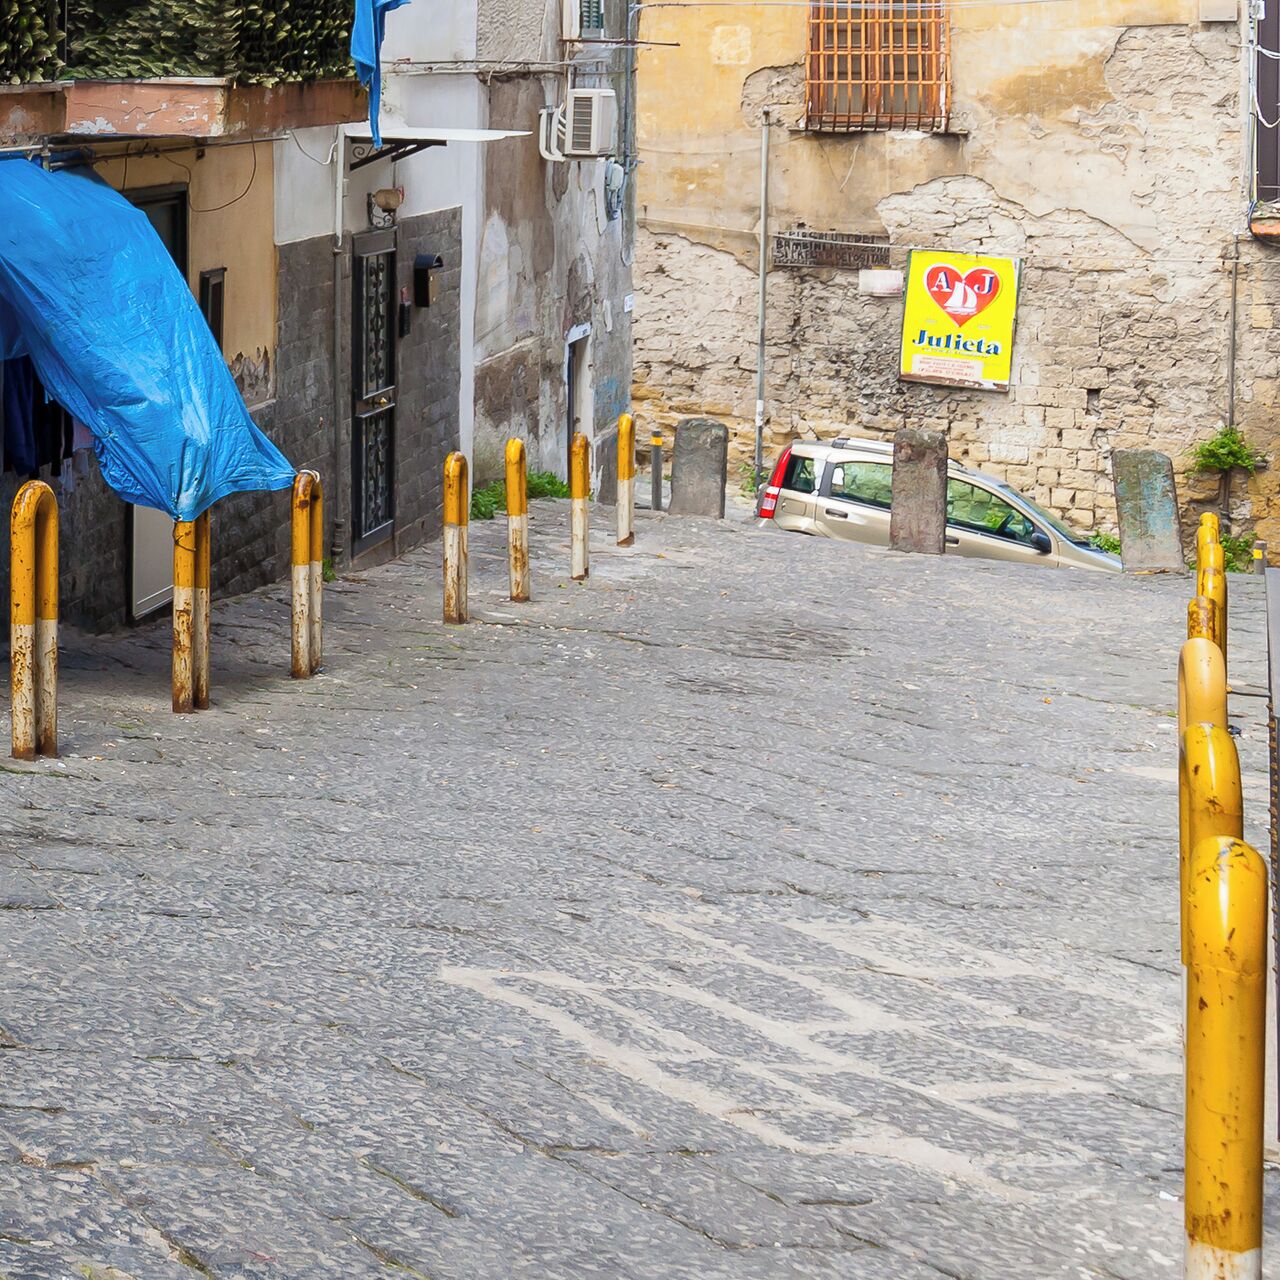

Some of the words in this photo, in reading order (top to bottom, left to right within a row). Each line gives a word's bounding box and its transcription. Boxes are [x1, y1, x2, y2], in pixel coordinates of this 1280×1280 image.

[930, 271, 953, 293] A
[973, 273, 996, 295] J
[912, 330, 1000, 355] Julieta
